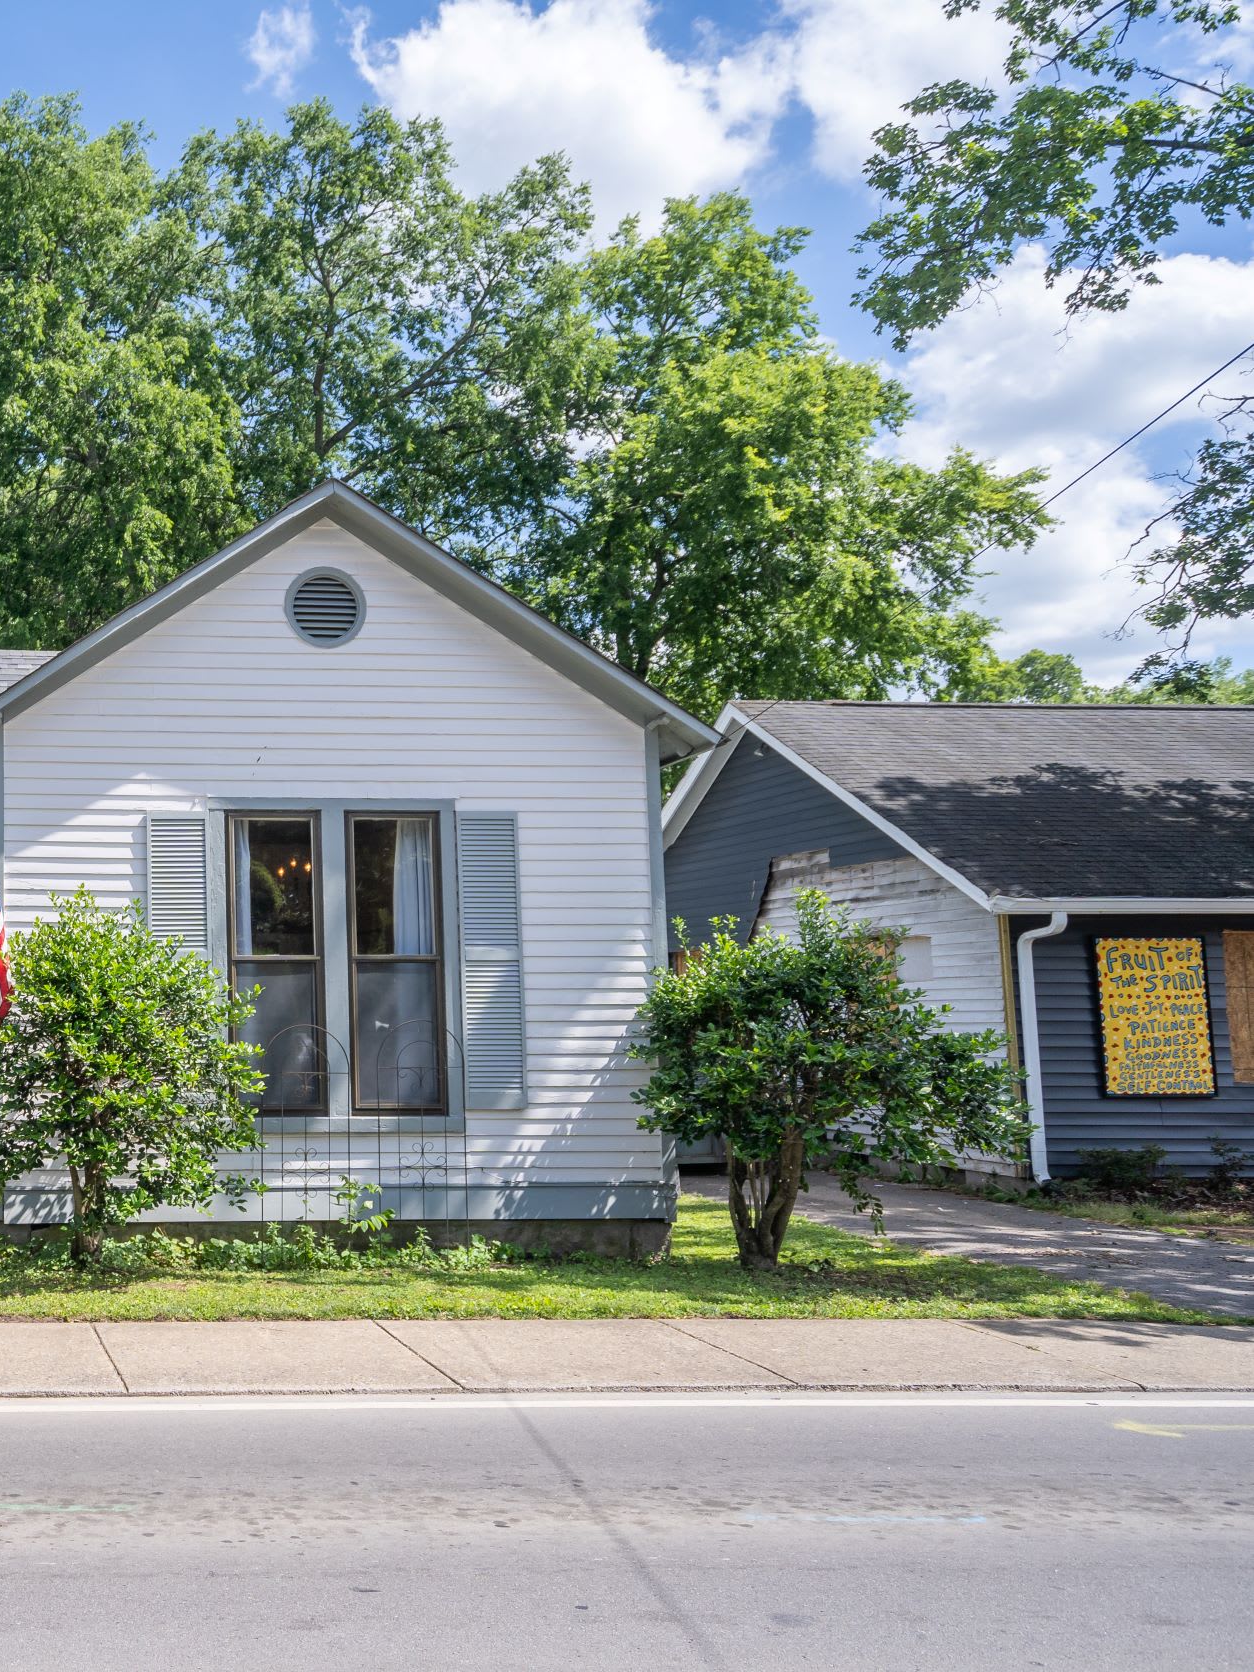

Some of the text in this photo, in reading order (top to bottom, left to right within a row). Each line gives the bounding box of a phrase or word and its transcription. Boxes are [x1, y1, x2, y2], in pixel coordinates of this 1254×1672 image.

[1106, 946, 1193, 973] FRUIT OF
[1110, 964, 1202, 992] THE SPIRIT
[1109, 1001, 1203, 1019] LOVE JOY PEACE
[1127, 1018, 1196, 1035] PATIENCE
[1123, 1033, 1198, 1050] KINDNESS
[1126, 1048, 1197, 1063] GOODNESS
[1119, 1060, 1199, 1071] FAITHFULNESS
[1120, 1070, 1200, 1081] GENTLENESS
[1117, 1080, 1210, 1091] SELF CONTROL
